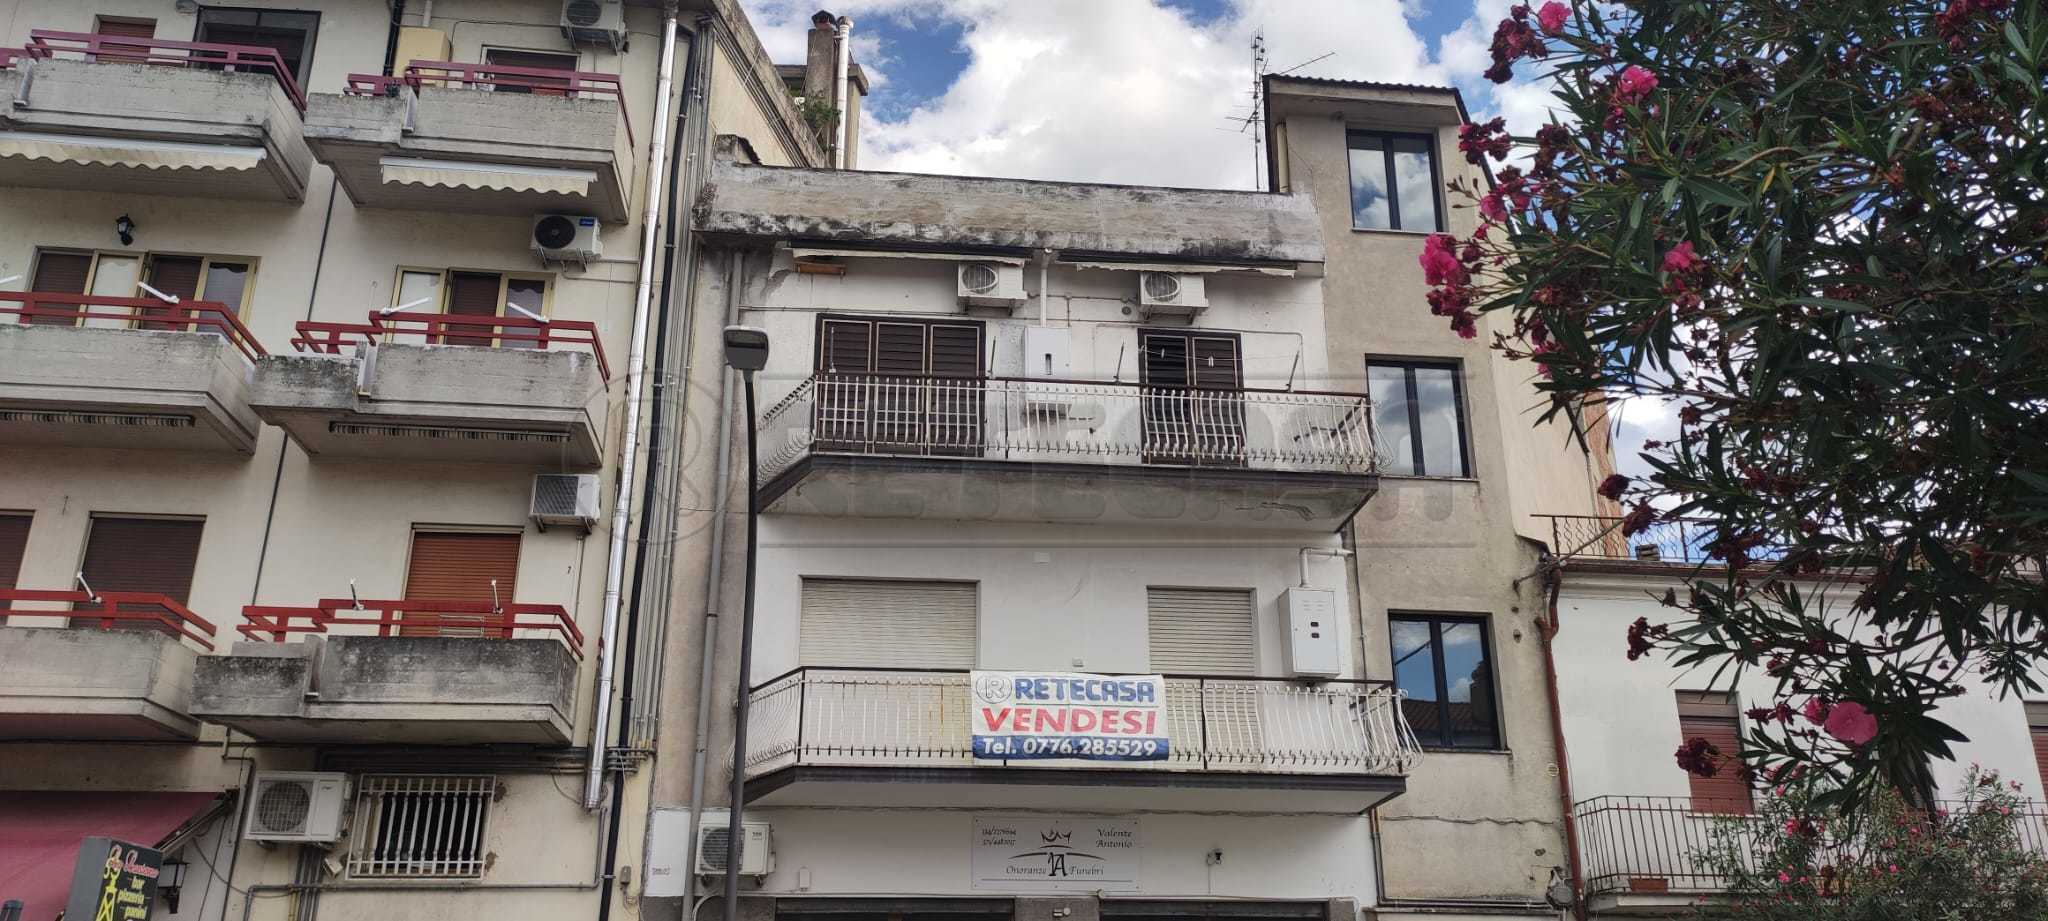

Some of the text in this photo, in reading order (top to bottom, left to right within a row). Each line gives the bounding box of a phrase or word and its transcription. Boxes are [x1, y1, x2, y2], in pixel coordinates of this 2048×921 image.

[1015, 678, 1154, 702] RETECASA
[982, 708, 1156, 734] VENDESI
[983, 737, 1157, 756] Tel. 0776.285529
[1096, 839, 1132, 848] Antonio
[1070, 865, 1104, 875] Funebri
